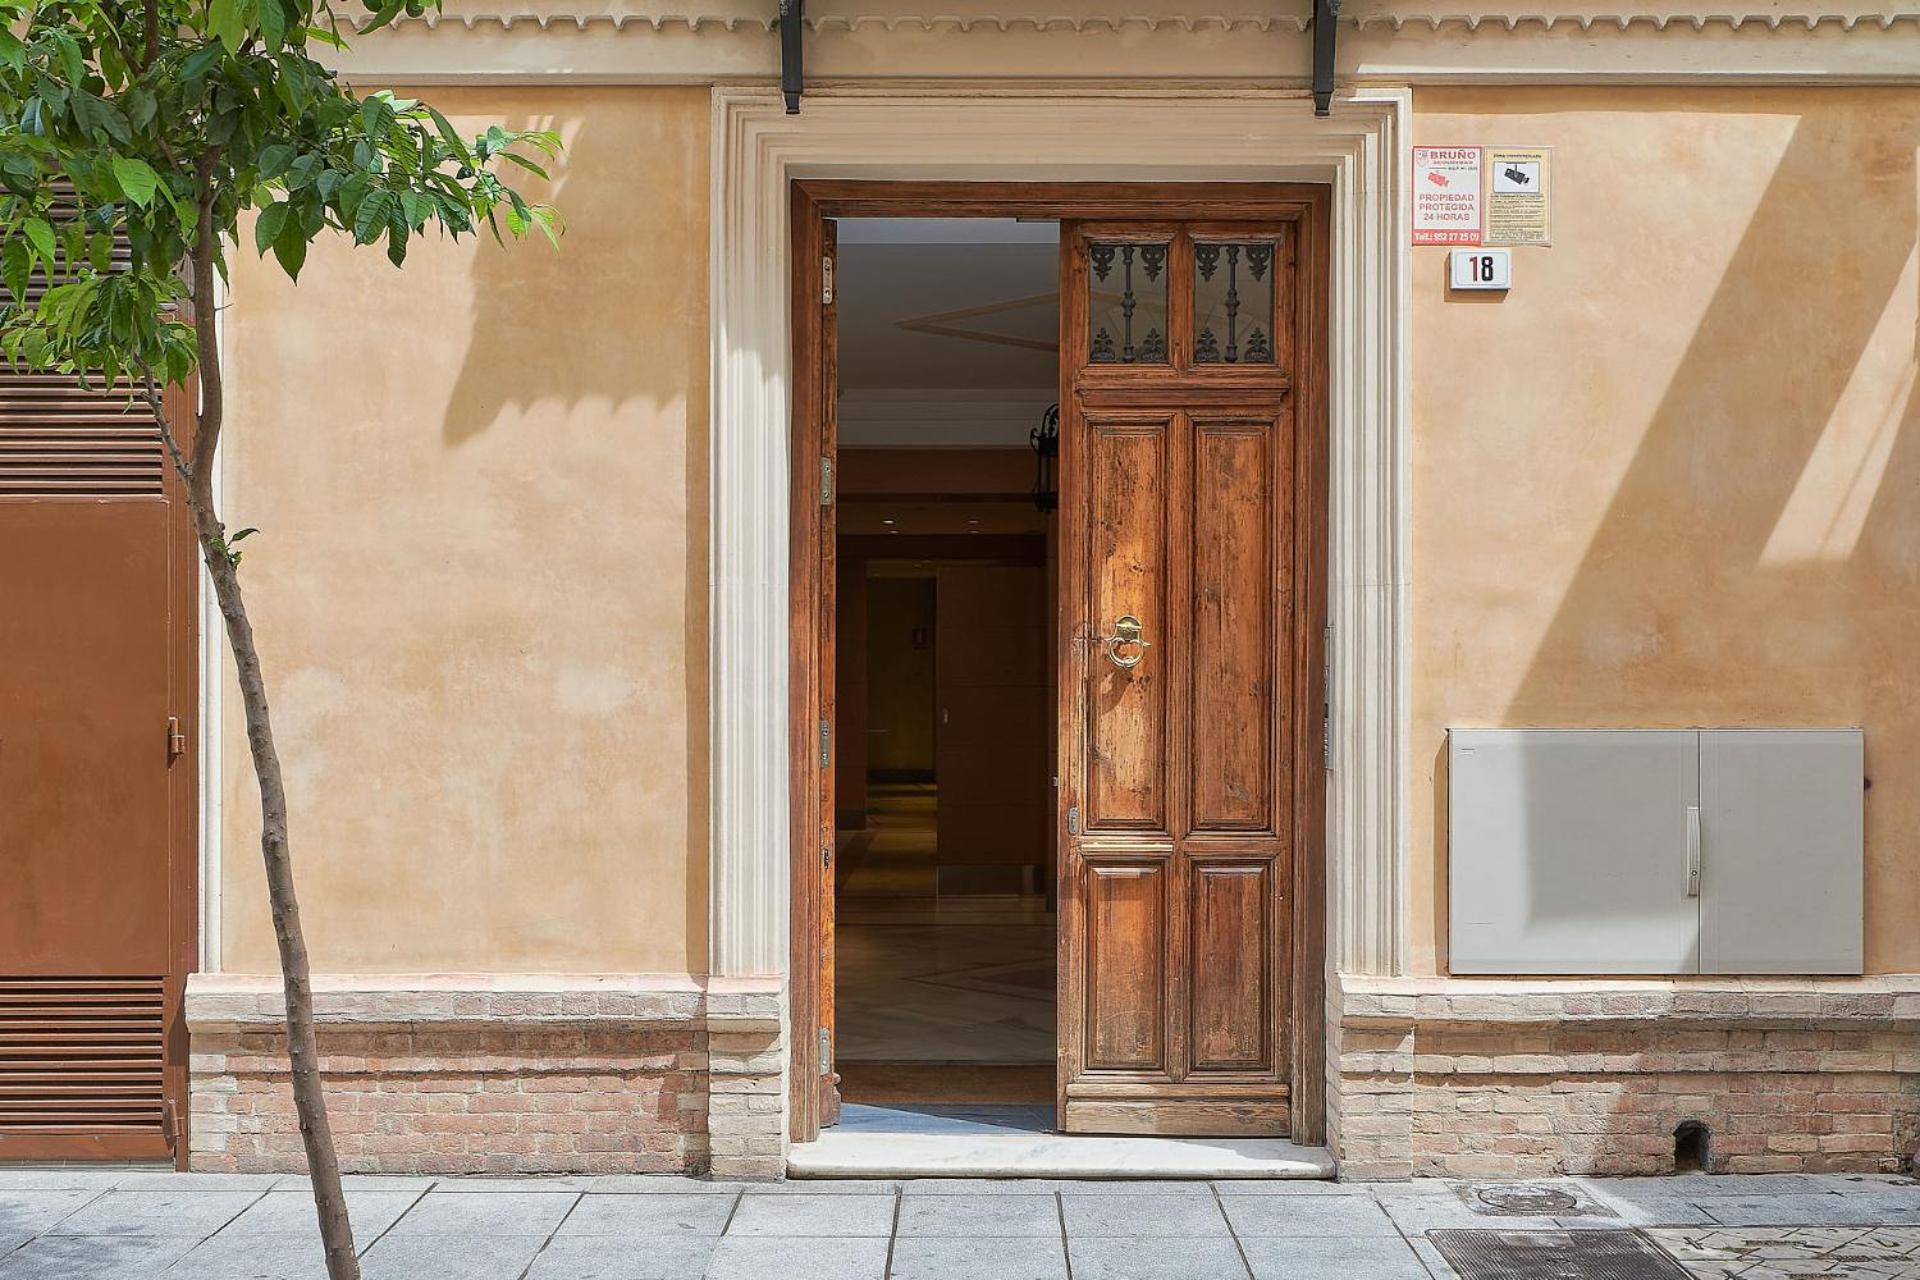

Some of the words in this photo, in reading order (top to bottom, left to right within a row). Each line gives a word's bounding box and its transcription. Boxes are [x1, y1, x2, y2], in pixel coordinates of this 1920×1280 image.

[1430, 149, 1476, 159] BRUÑO
[1419, 203, 1474, 211] PROTEGIDA
[1423, 213, 1434, 221] 24
[1436, 213, 1470, 221] HORAS
[1469, 256, 1494, 282] 18
